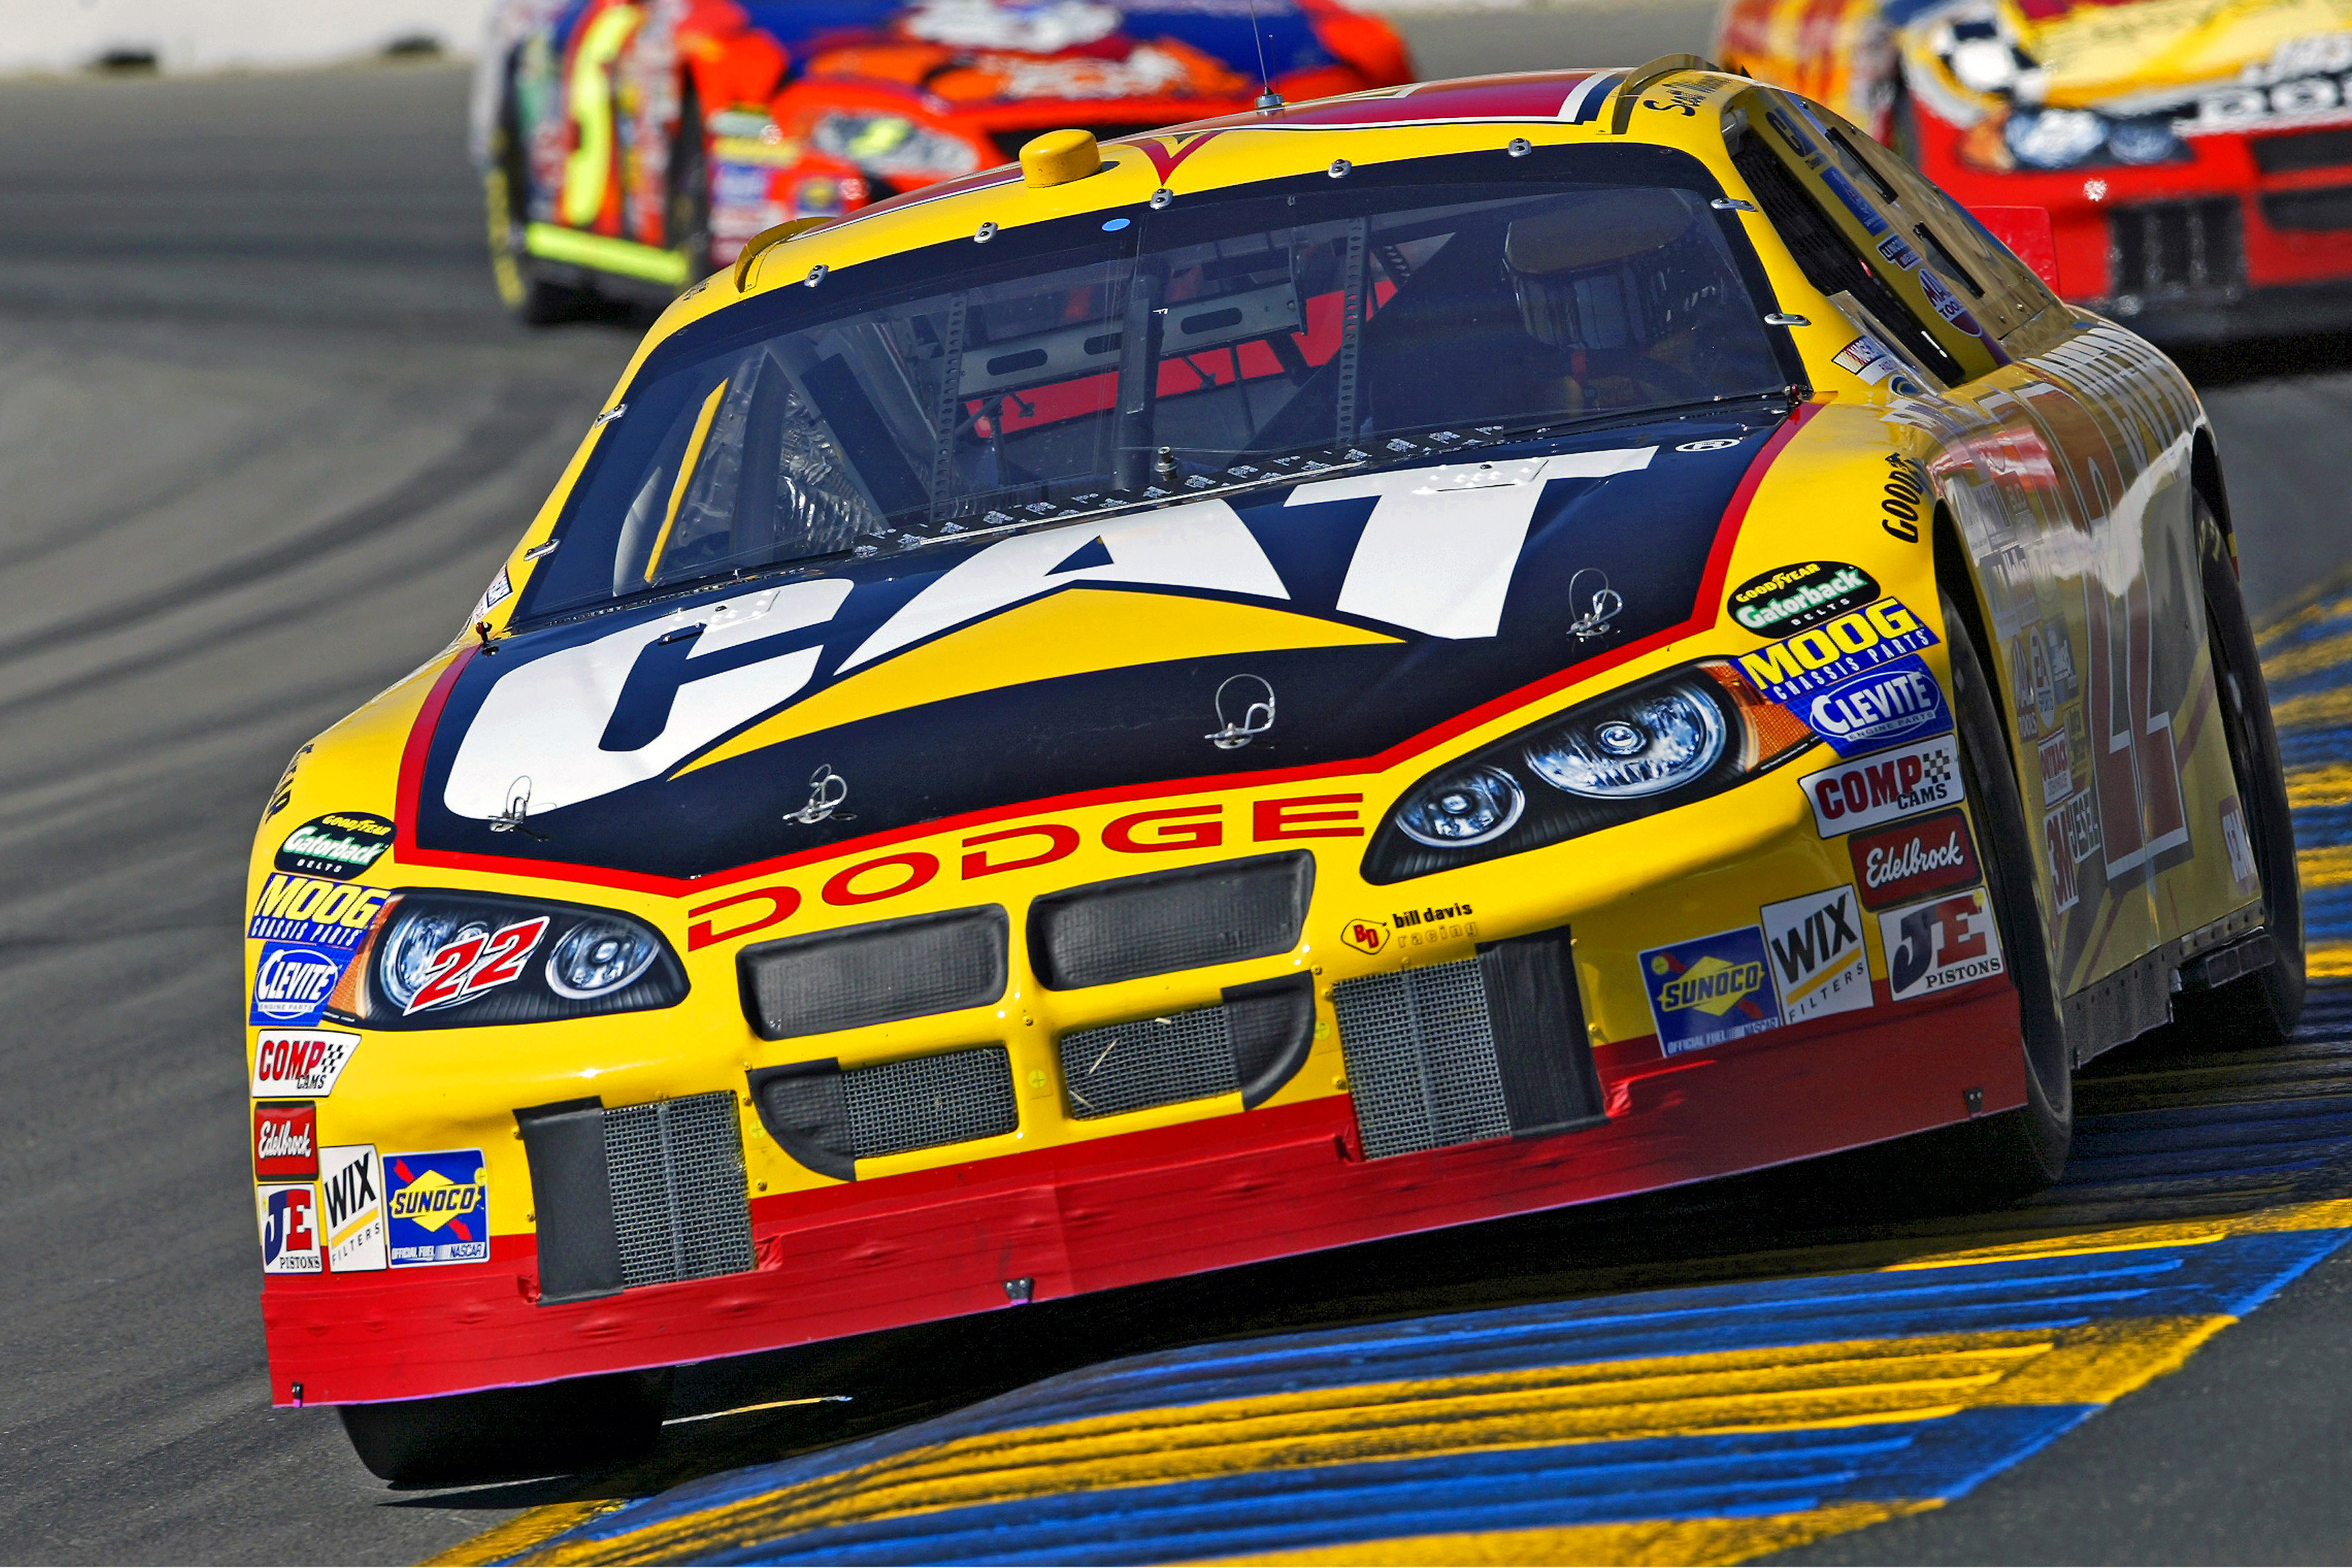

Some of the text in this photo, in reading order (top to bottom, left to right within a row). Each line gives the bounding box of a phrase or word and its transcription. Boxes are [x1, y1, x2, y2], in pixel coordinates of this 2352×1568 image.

[1736, 563, 1820, 603] GOODYEAR
[1736, 568, 1868, 629] Gatorback
[443, 445, 1659, 821] CAT
[1791, 598, 1850, 625] BELTS
[1738, 598, 1919, 690] MOOG
[1773, 630, 1929, 700] CHASSIS PARTS
[1812, 671, 1931, 734] CLEVITE
[1849, 710, 1936, 741] ENGINE PARTS
[1815, 754, 1923, 820] COMP
[1897, 783, 1948, 810] CAMS
[284, 824, 385, 867] Gatorback
[296, 859, 343, 873] BELTS
[1866, 832, 1964, 887] Edelbrock
[688, 793, 1365, 952] DODGE
[254, 875, 391, 929] MOOG
[1392, 902, 1473, 929] bill davis
[251, 918, 363, 946] CHASSIS PARTS
[1398, 922, 1477, 948] racing
[1771, 894, 1858, 984] WIX
[1892, 894, 1987, 993] JE
[258, 949, 337, 1000] CLEVITE
[402, 916, 551, 1017] 22
[1664, 964, 1760, 1009] SUNOCO
[1925, 959, 2002, 989] PISTONS
[288, 1003, 313, 1012] PARTS
[1787, 962, 1864, 1023] FILTERS
[259, 1041, 326, 1080] COMP
[297, 1074, 327, 1089] CAMS
[258, 1121, 312, 1158] Edelbrock
[325, 1152, 377, 1227] WIX
[394, 1188, 475, 1216] SUNOCO
[264, 1189, 312, 1266] JE
[331, 1224, 381, 1265] FILTERS
[279, 1254, 323, 1269] PISTONS
